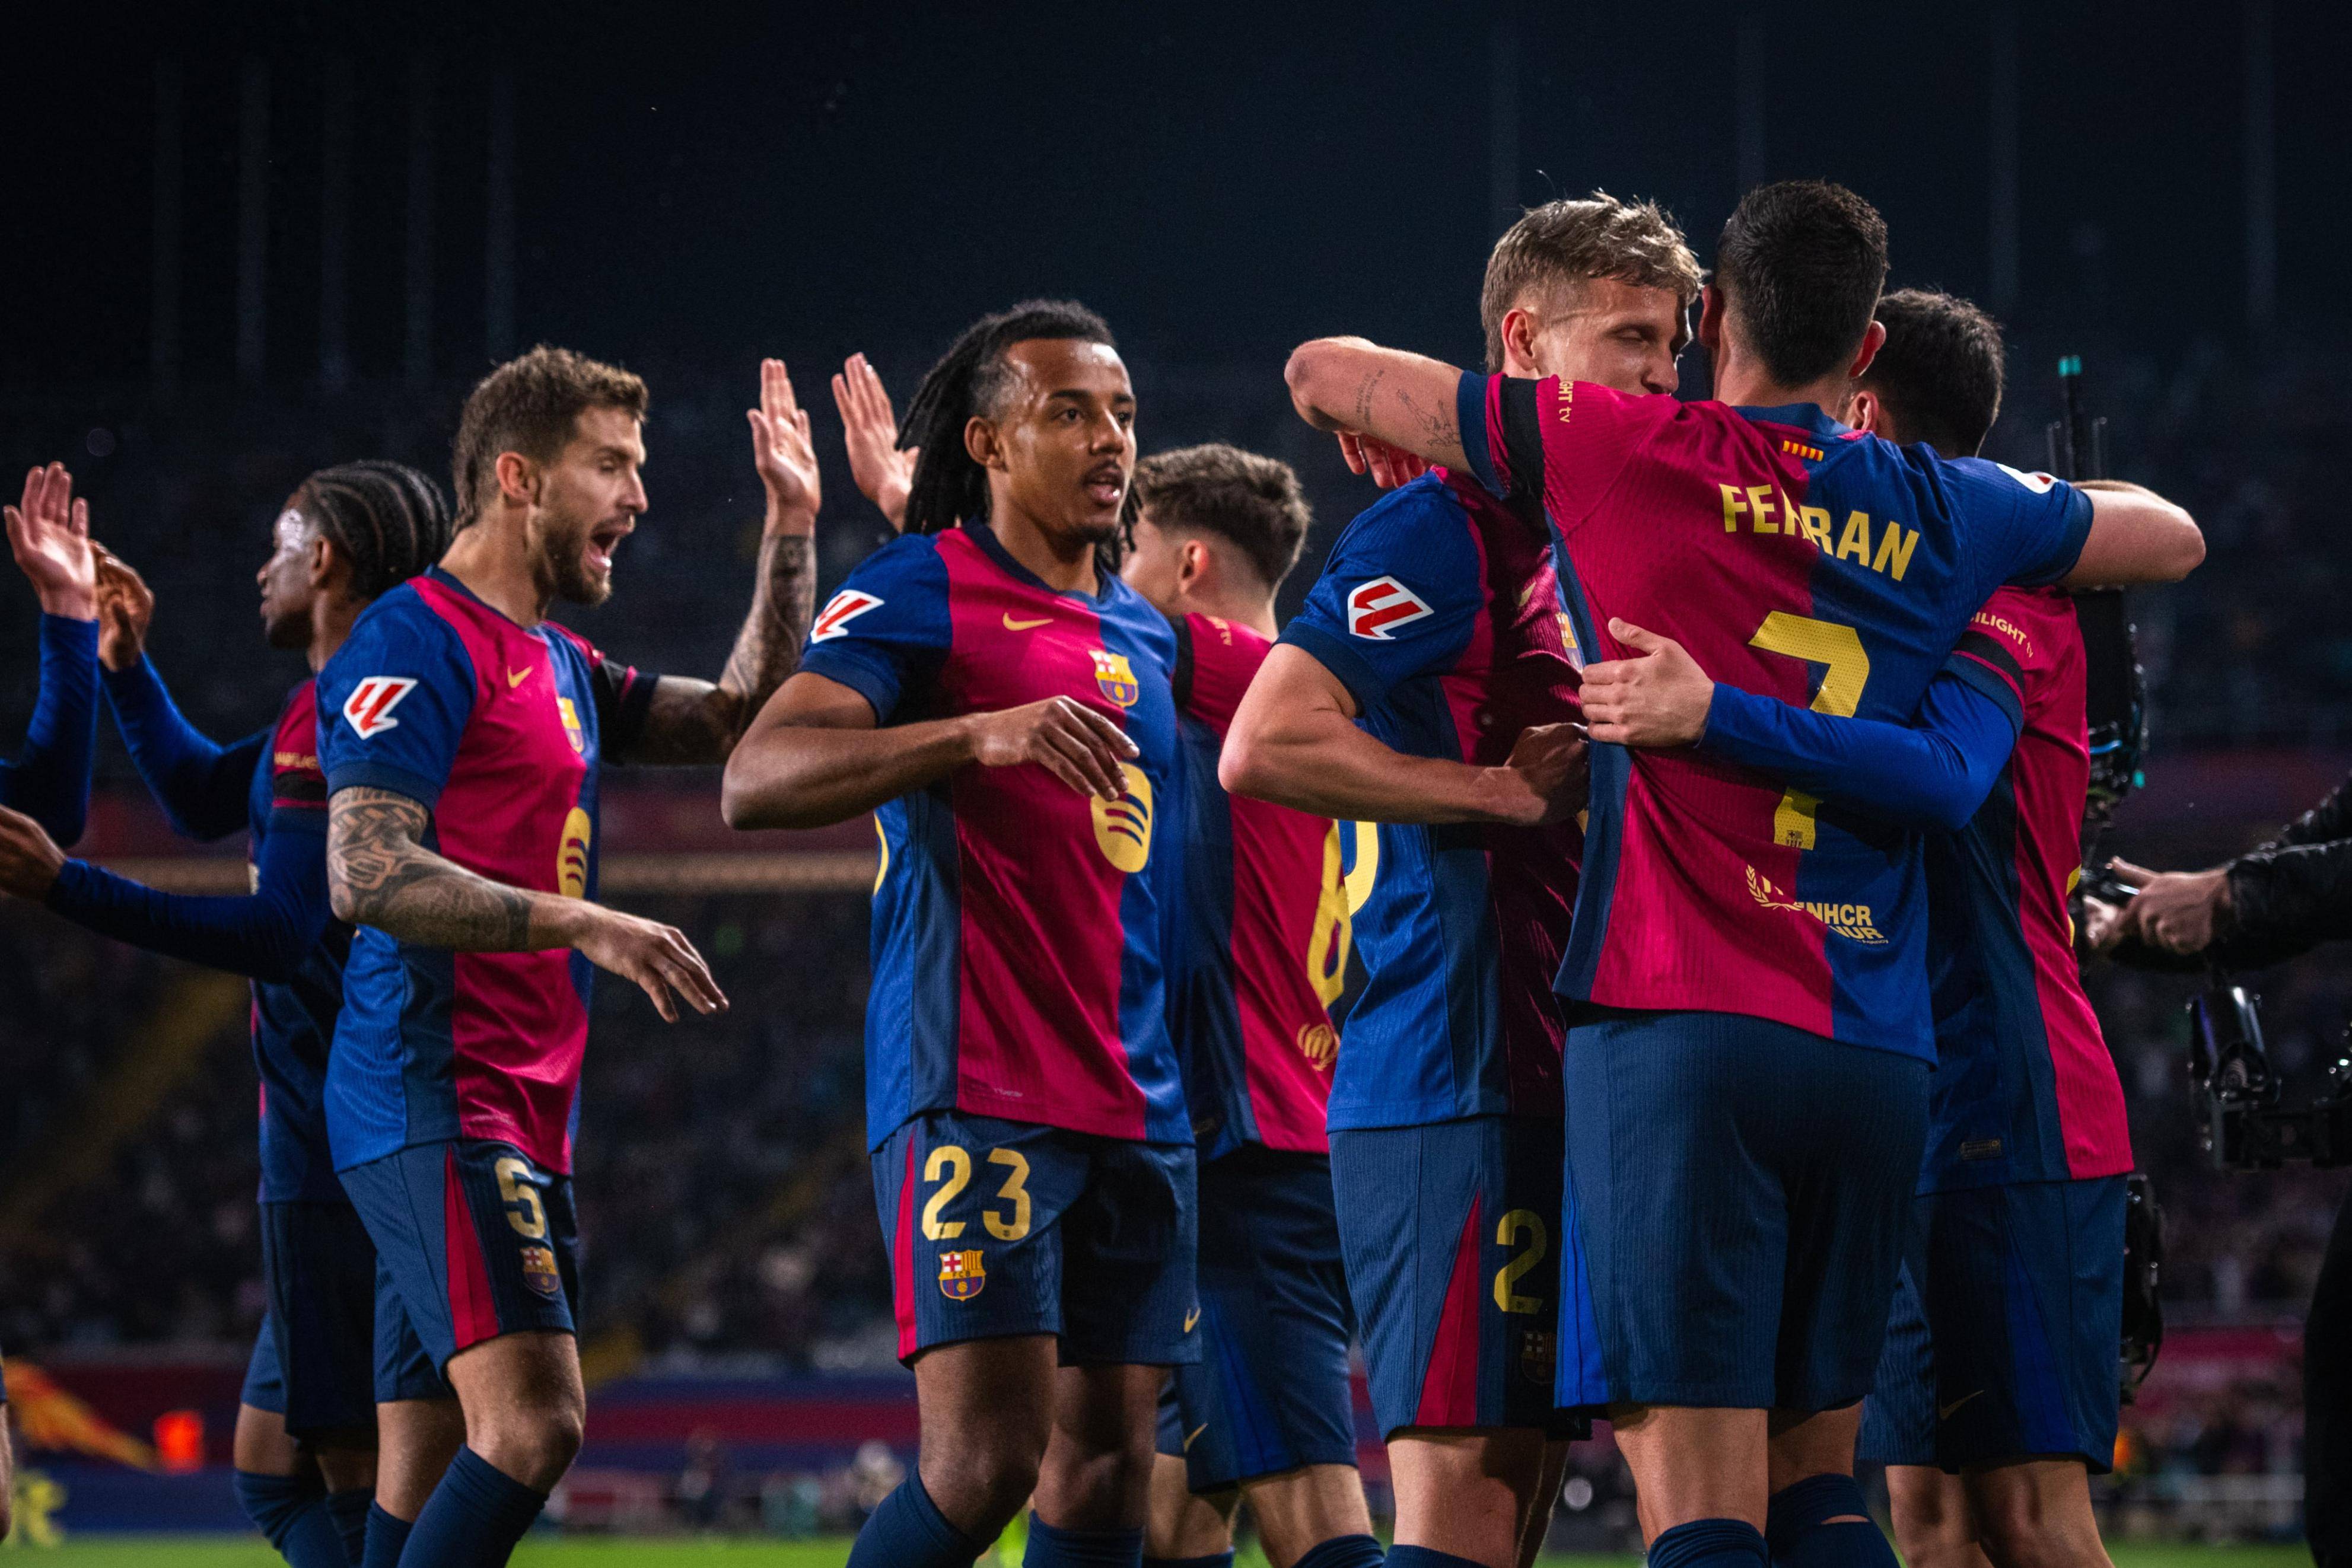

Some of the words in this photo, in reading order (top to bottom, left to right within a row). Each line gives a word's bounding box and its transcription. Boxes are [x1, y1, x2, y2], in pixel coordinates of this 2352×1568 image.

[1971, 611, 2027, 645] ILIGHT
[1748, 610, 1870, 850] 7
[494, 1156, 546, 1240] 5
[922, 1145, 1031, 1241] 23
